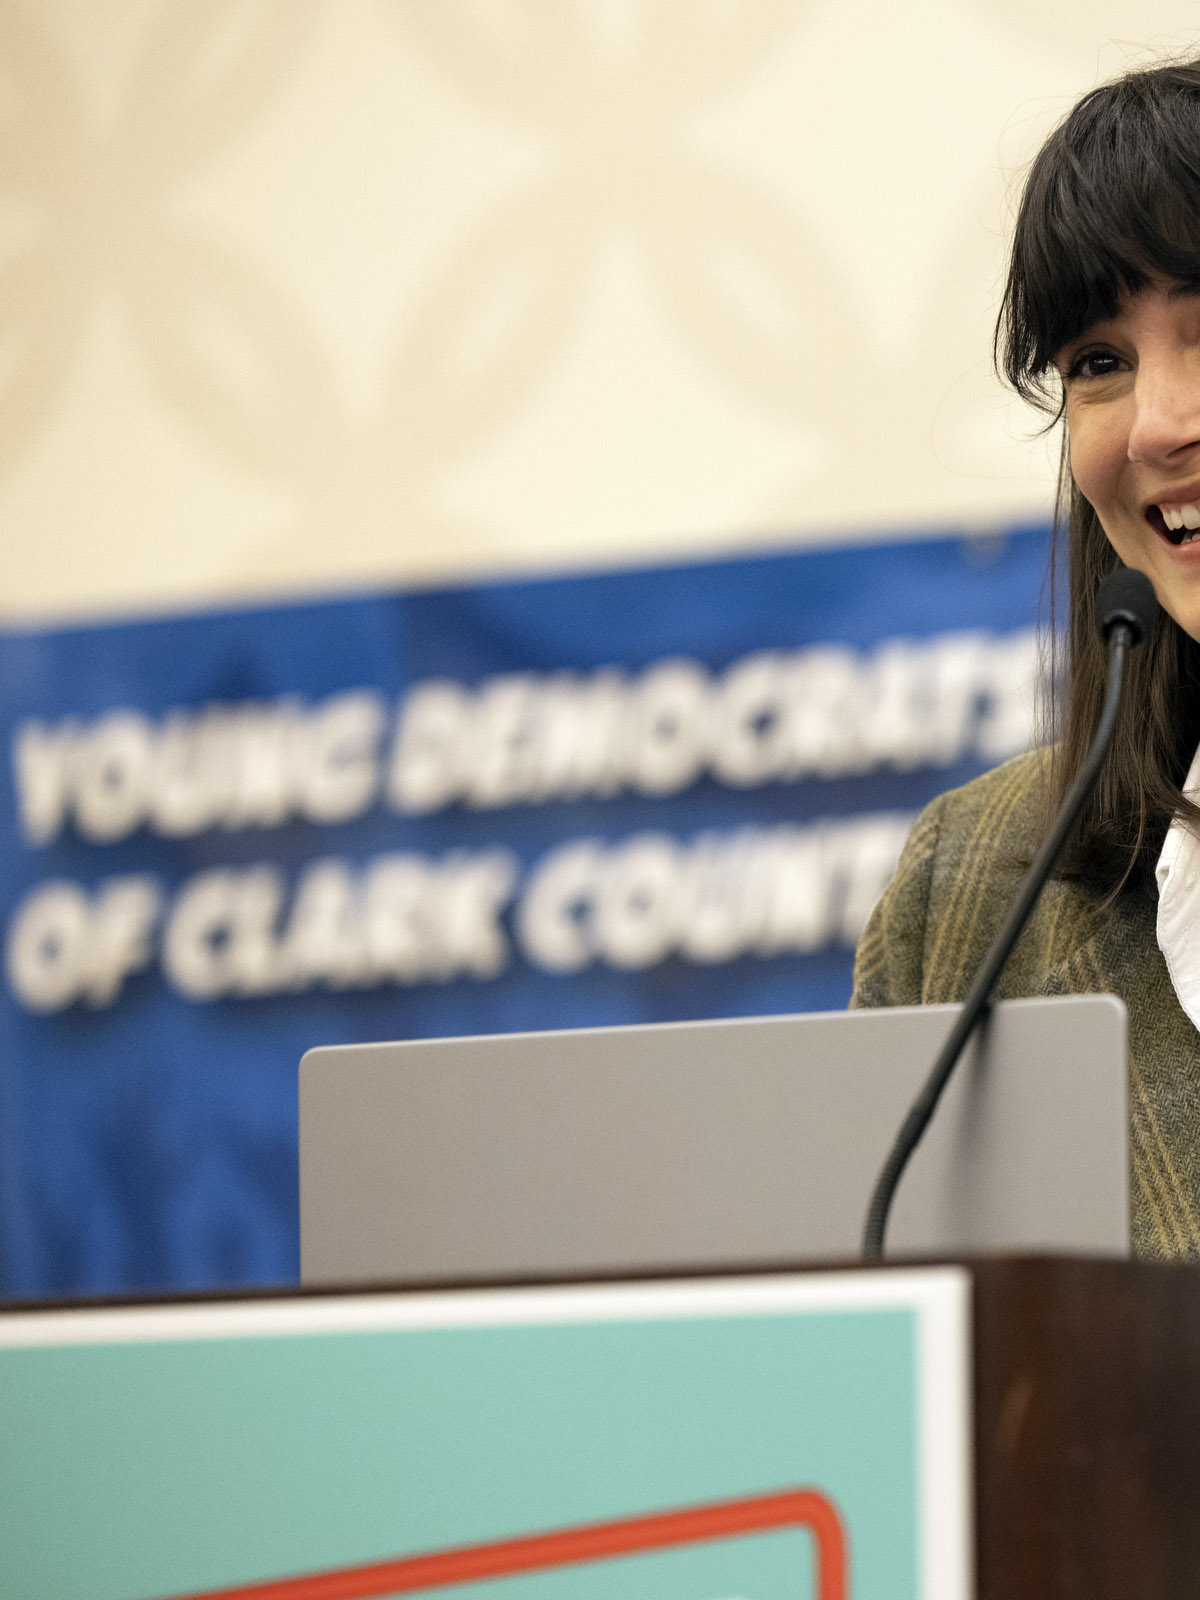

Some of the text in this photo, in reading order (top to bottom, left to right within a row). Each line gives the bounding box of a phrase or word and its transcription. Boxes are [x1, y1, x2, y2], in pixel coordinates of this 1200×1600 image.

[17, 631, 1068, 844] YOUNG DEMOCRATS
[9, 819, 912, 1011] OF CLARK COUNT
